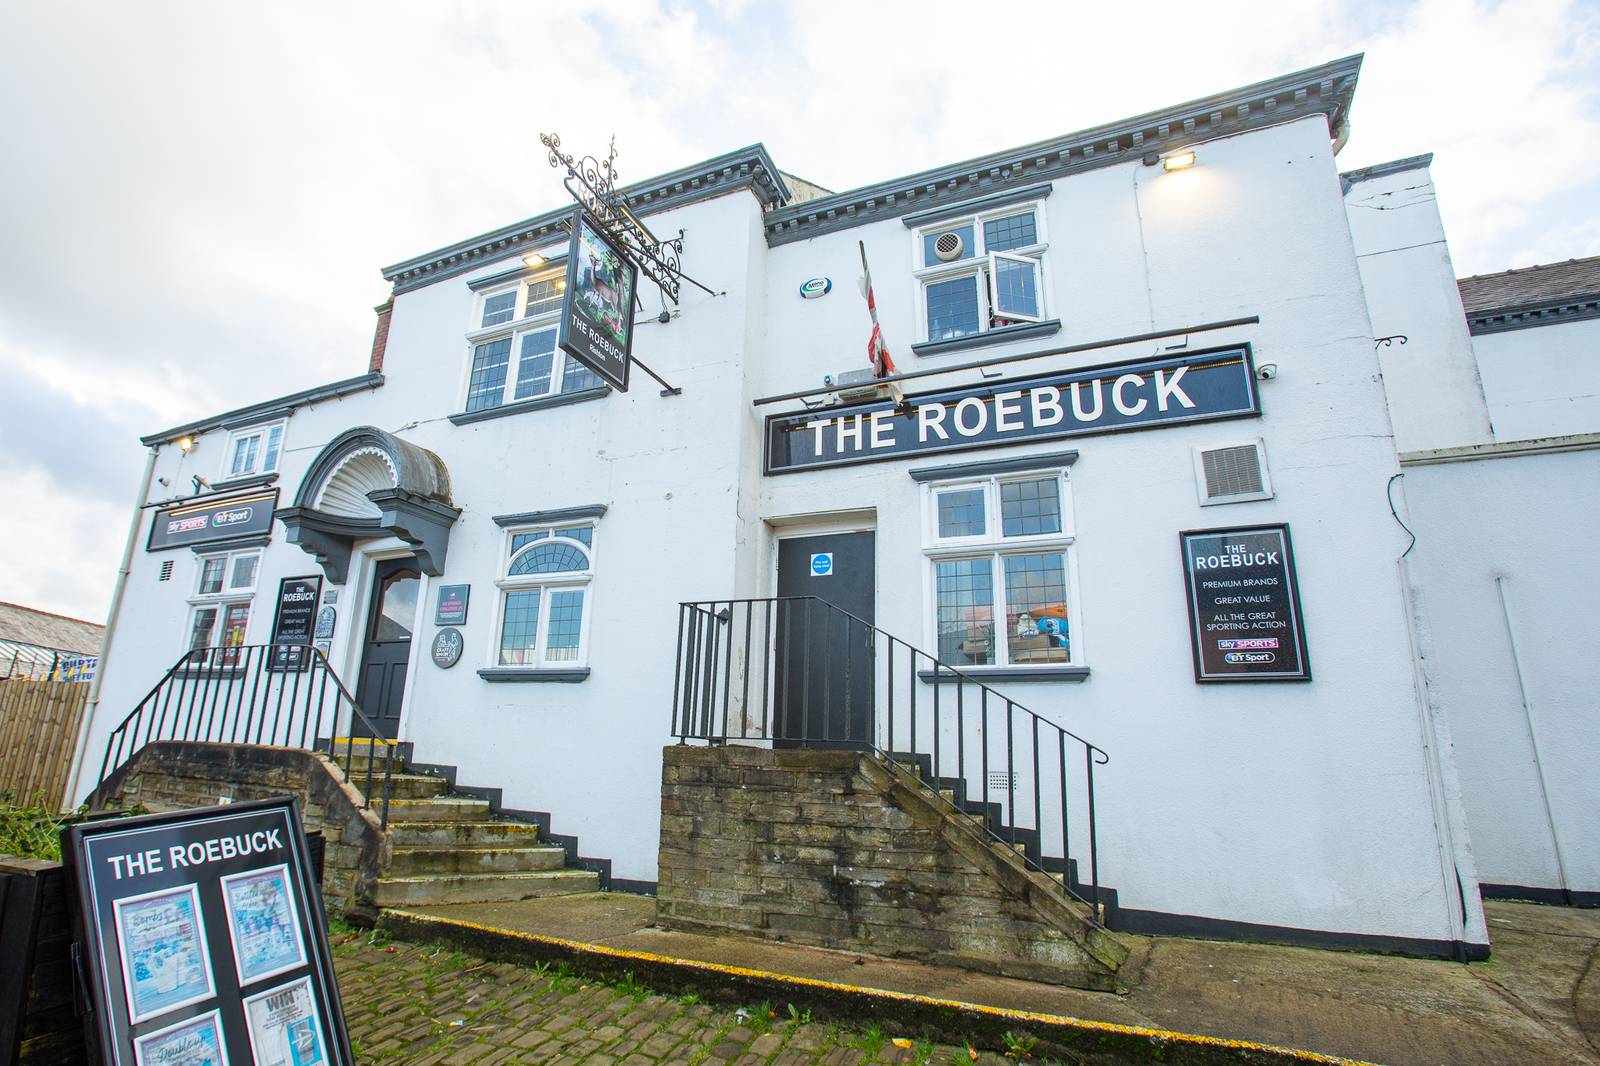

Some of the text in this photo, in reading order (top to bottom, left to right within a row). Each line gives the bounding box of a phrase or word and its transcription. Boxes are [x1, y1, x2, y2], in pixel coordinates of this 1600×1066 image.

[572, 314, 624, 363] THE ROEBUCK
[807, 366, 1196, 457] THE ROEBUCK
[228, 510, 248, 522] Sport
[1225, 544, 1247, 553] THE
[1196, 552, 1279, 569] ROEBUCK
[1203, 578, 1278, 589] PREMIUM BRANDS
[283, 592, 315, 602] ROEBUCK
[1214, 595, 1271, 605] GREAT VALUE
[1214, 613, 1228, 621] ALL
[1248, 612, 1276, 620] GREAT
[1206, 621, 1286, 631] SPORTING ACTION
[1221, 639, 1277, 649] sky SPORTS
[1231, 654, 1270, 662] BT Sport
[107, 828, 283, 880] THE ROEBUCK
